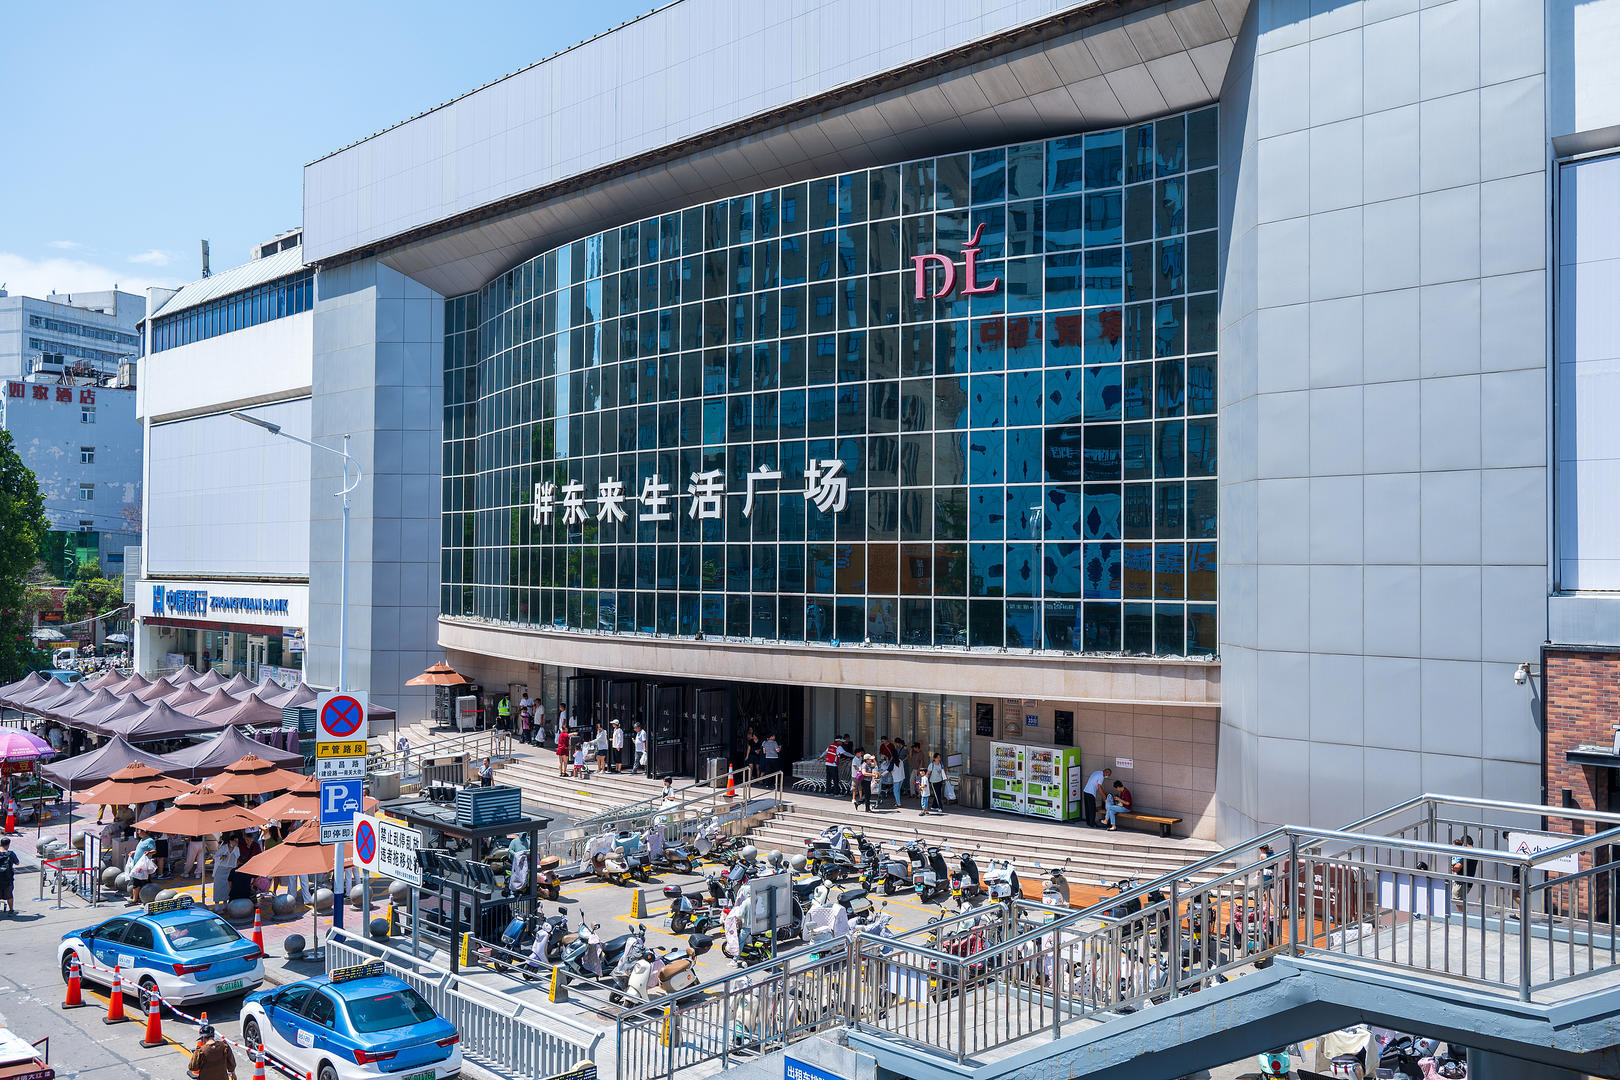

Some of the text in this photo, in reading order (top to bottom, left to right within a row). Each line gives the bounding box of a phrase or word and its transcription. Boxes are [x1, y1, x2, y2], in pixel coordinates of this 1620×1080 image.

[9, 382, 96, 405] 如家酒店
[533, 459, 848, 526] 胖东来生活广场
[166, 589, 289, 614] 中原银行 ZHONGYUAN BANK
[321, 744, 363, 754] 严管路段
[325, 785, 349, 813] P
[323, 829, 354, 839] 即停即
[380, 827, 420, 852] 禁止乱停乱放
